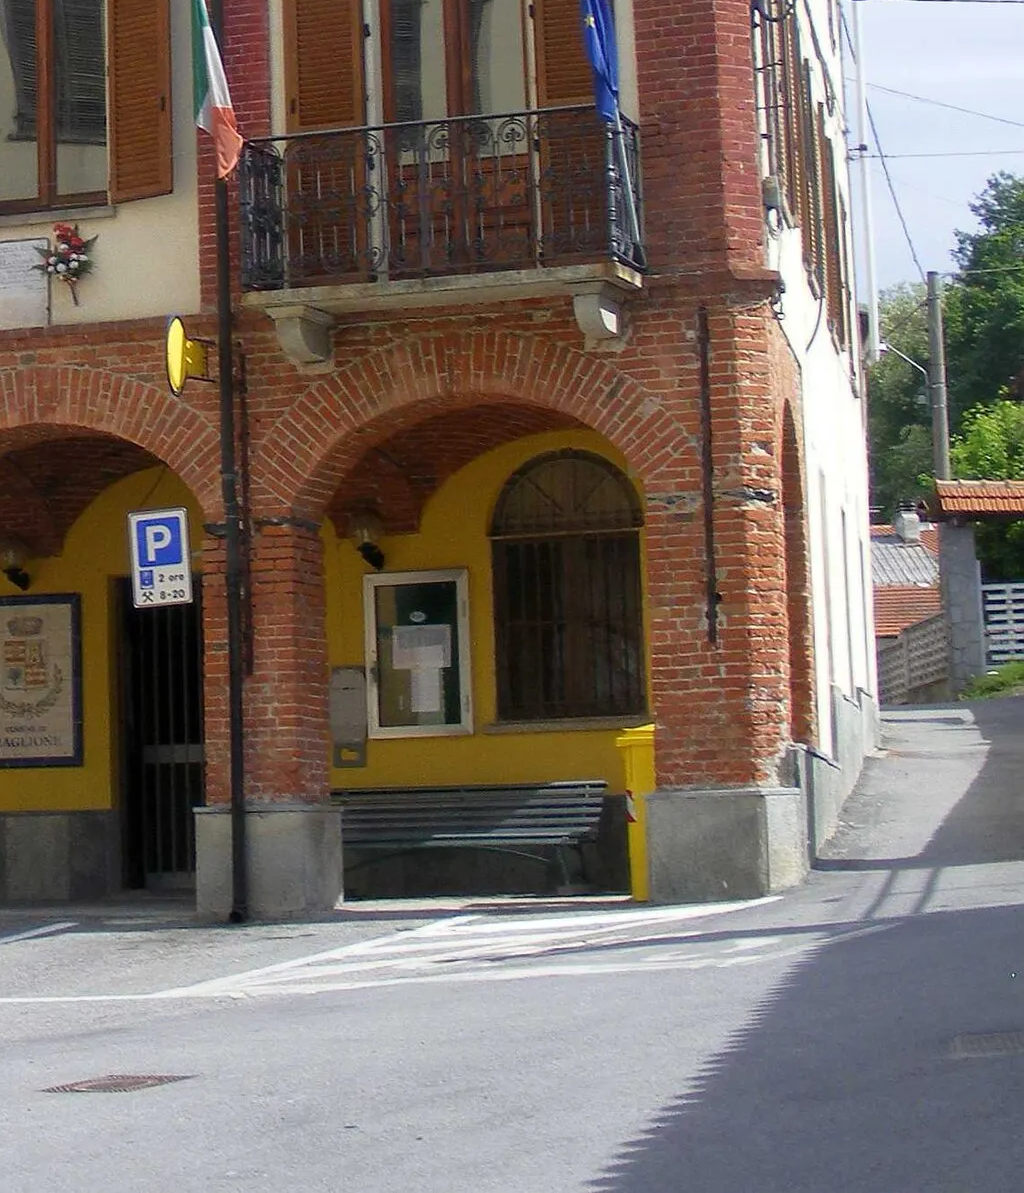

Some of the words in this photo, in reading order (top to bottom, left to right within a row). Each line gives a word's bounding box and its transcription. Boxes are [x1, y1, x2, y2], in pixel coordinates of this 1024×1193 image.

[145, 524, 172, 562] P
[158, 573, 165, 583] 2
[168, 573, 185, 582] ore
[159, 589, 186, 601] 8-20
